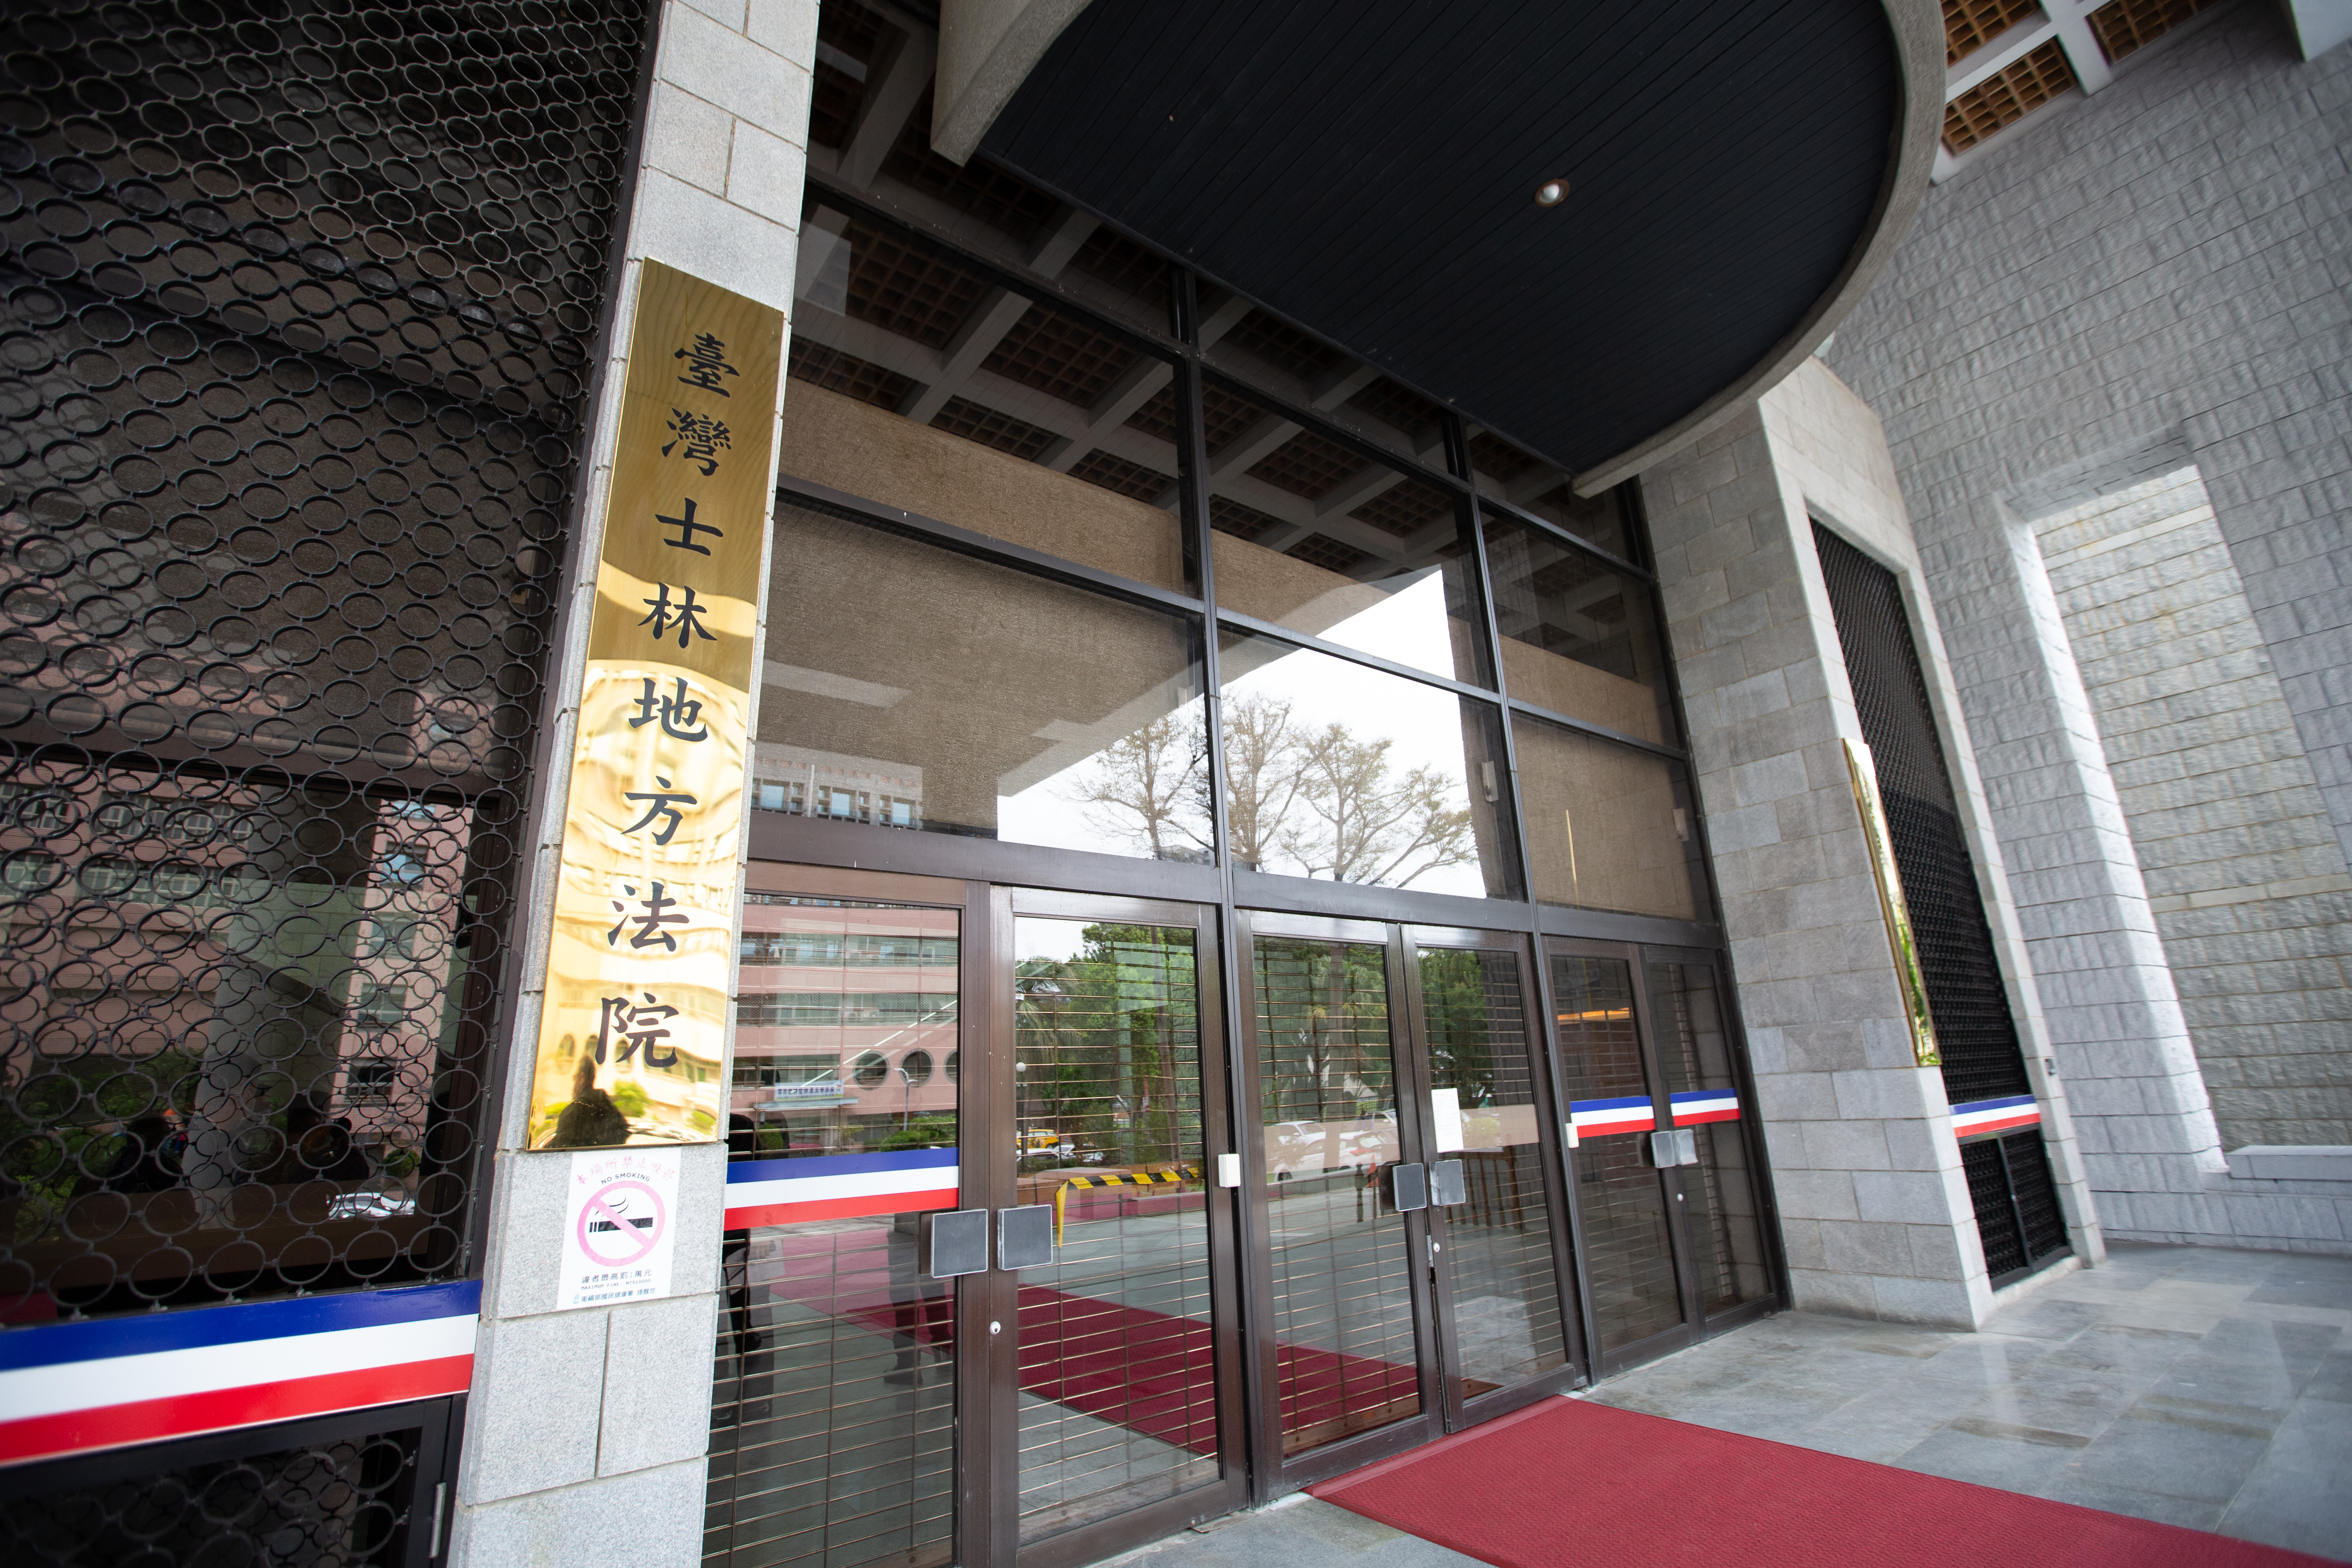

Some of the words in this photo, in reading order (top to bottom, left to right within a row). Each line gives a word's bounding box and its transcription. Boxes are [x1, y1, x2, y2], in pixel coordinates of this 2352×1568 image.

[595, 332, 740, 1068] 臺灣士林地方法院
[577, 1155, 675, 1185] 本場所禁止吸菸
[615, 1172, 651, 1182] SMOKING
[581, 1269, 651, 1284] 違者最高罰1萬元
[581, 1290, 633, 1302] 衛福部國民健康署
